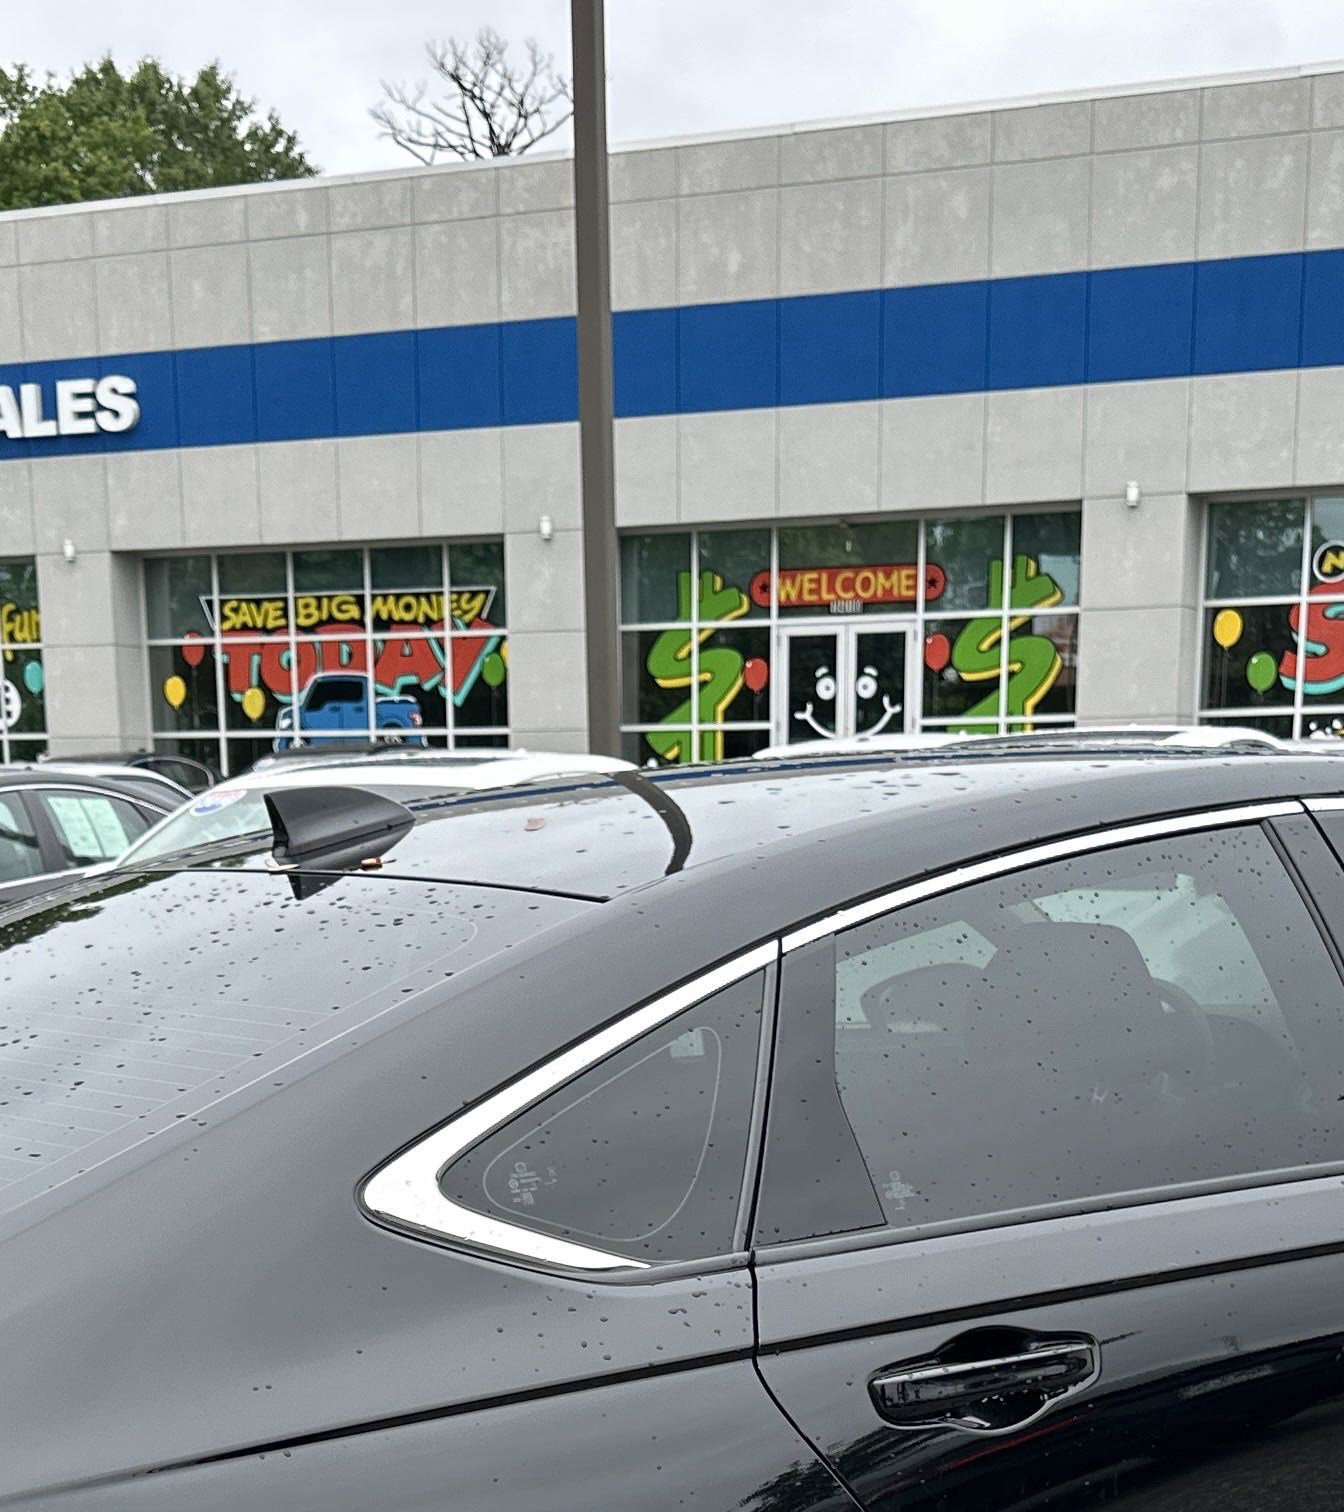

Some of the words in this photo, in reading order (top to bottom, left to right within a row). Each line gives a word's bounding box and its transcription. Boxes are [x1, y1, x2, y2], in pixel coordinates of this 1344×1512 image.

[777, 568, 917, 601] WELCOME
[220, 599, 288, 631] SAVE
[296, 594, 361, 627] BIG
[371, 592, 487, 625] MONEY
[216, 618, 501, 706] TODAY
